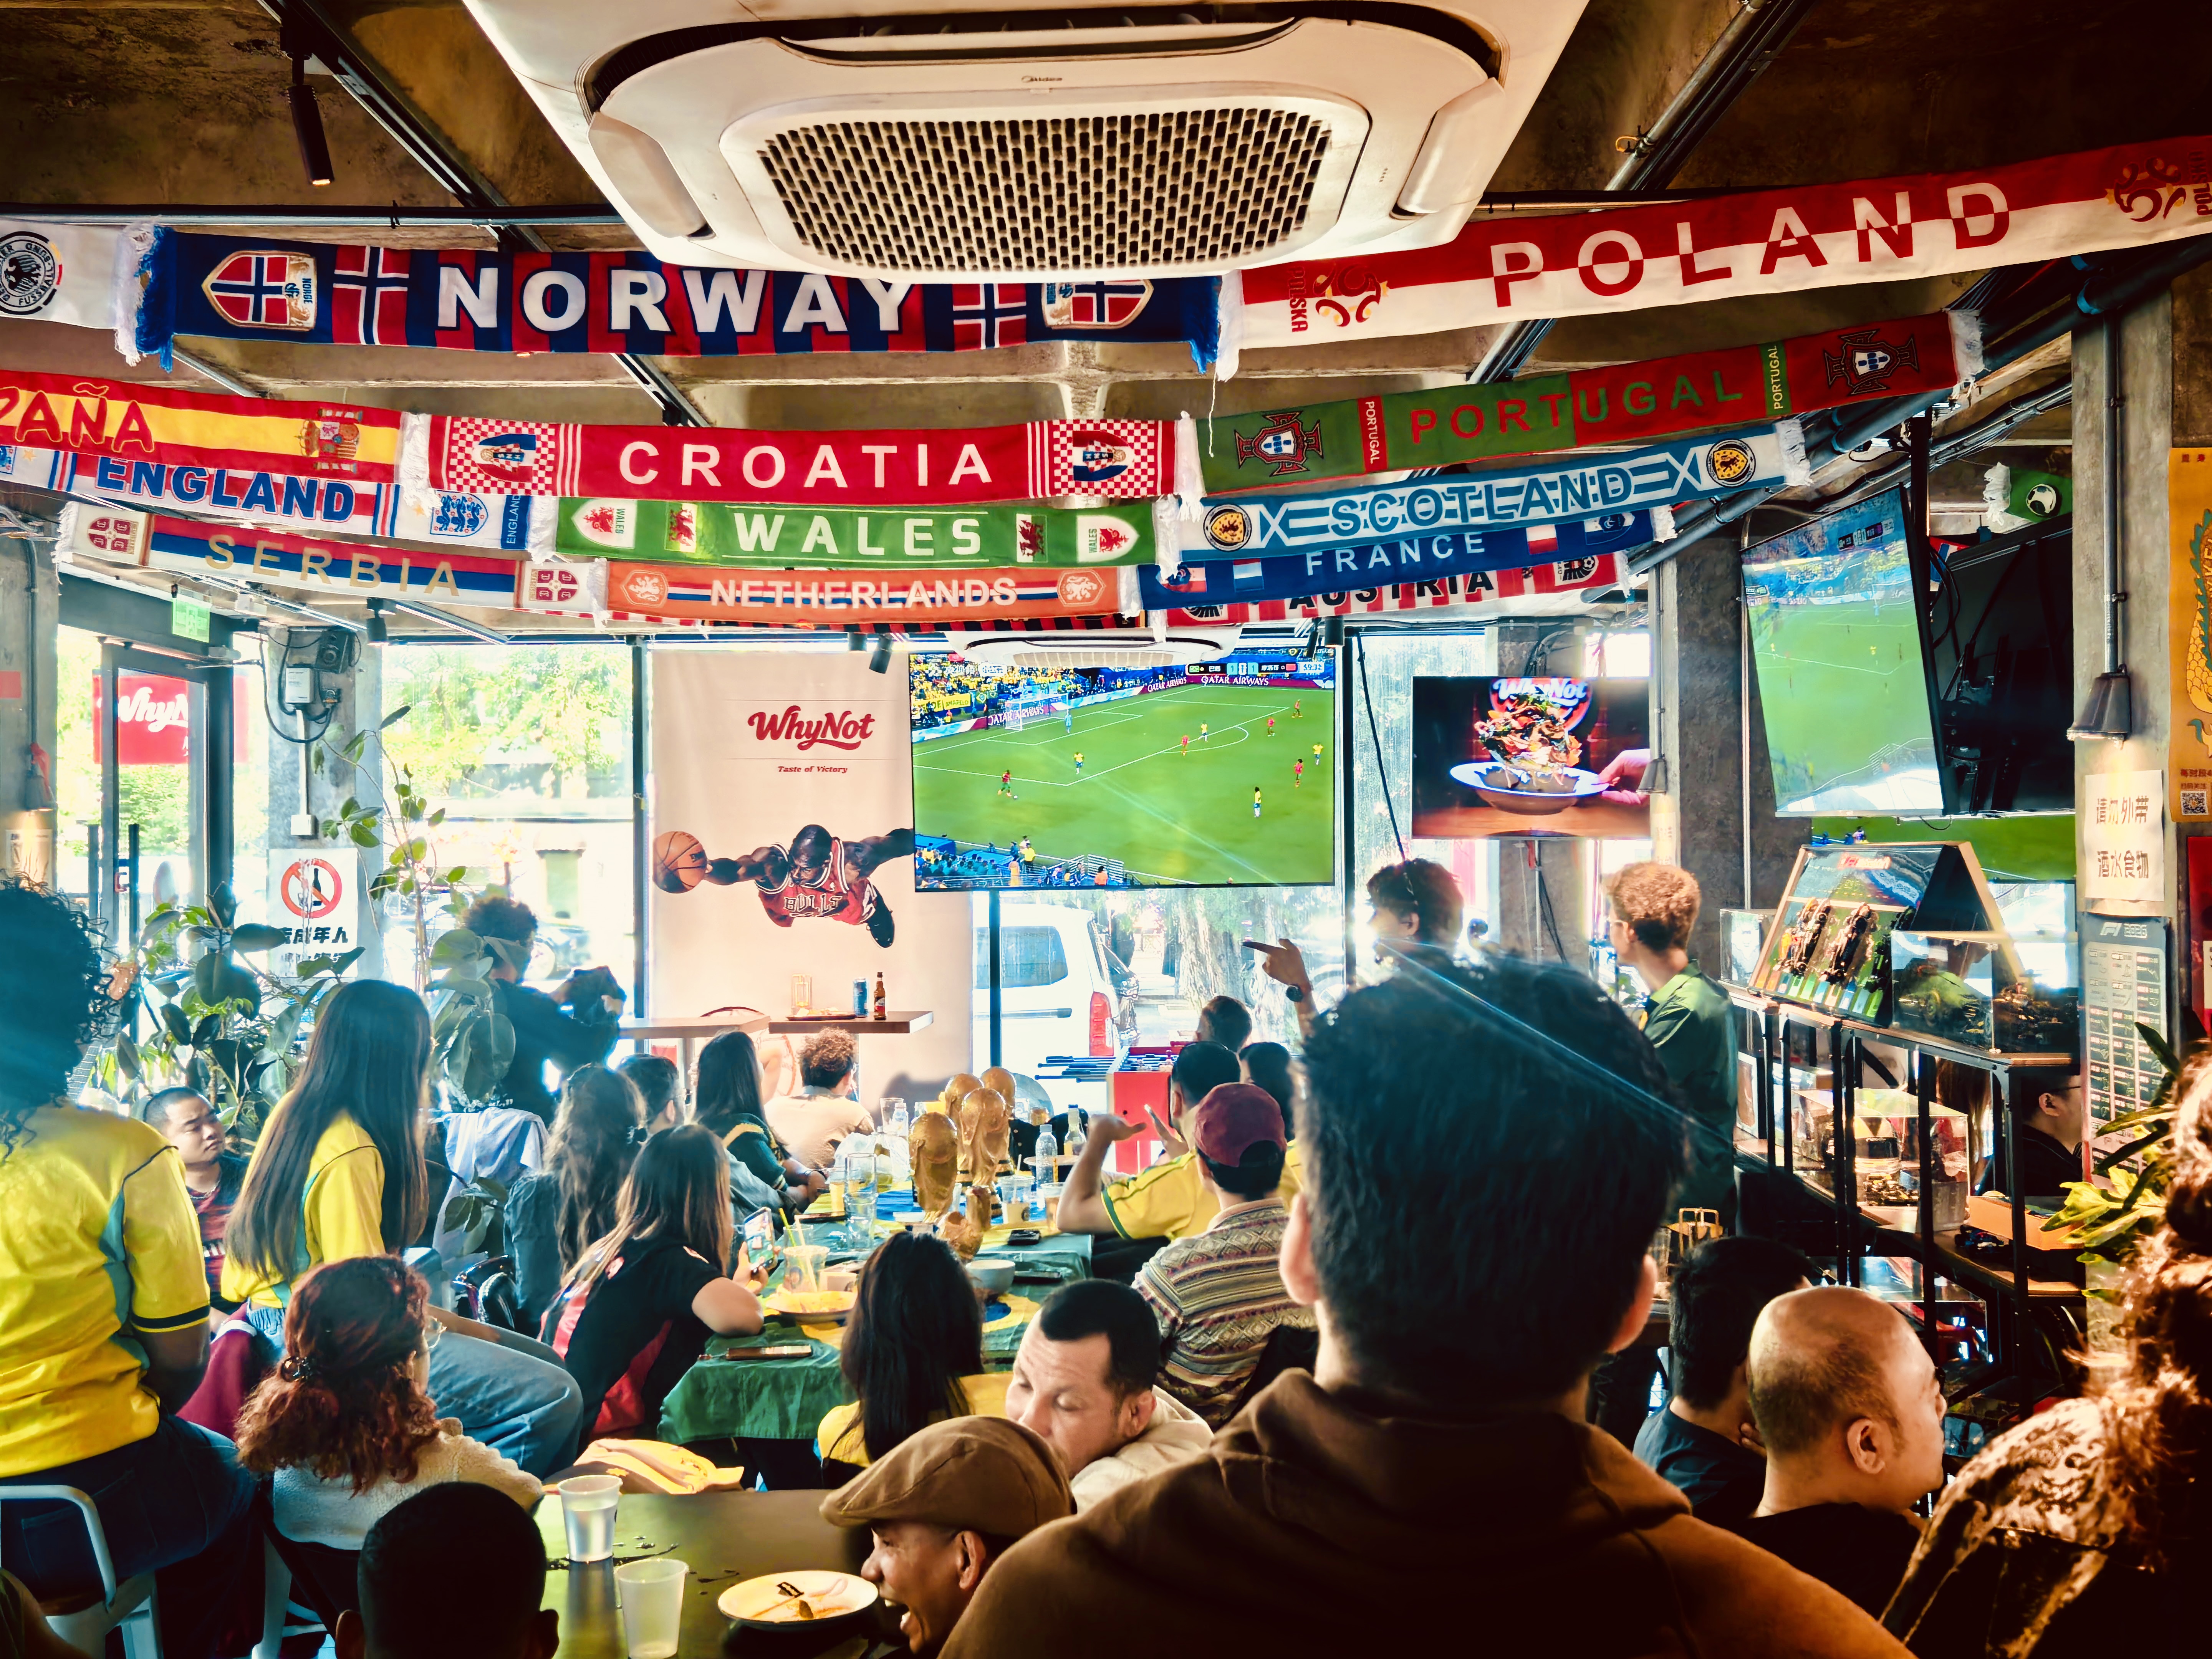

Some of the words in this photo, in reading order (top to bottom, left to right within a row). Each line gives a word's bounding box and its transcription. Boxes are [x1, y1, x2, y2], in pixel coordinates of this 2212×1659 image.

[1490, 183, 2009, 306] POLAND
[437, 267, 912, 332] NORWAY
[1287, 266, 1308, 332] POLSKA
[1411, 371, 1742, 444] PORTUGAL
[1770, 345, 1782, 409] PORTUGAL
[1365, 401, 1381, 464] PORTUGAL
[95, 453, 358, 523] ENGLAND
[619, 441, 992, 488] CROATIA
[1332, 467, 1633, 536] SCOTLAND
[734, 513, 981, 556] WALES
[1306, 534, 1486, 575] FRANCE
[205, 535, 459, 596] SERBIA
[711, 578, 1017, 609] NETHERLANDS
[1201, 675, 1229, 685] QATAR
[1232, 675, 1269, 686] AIRWAYS
[747, 705, 875, 750] WhyNot
[2096, 795, 2149, 824] 请勿外带
[2097, 849, 2149, 879] 酒水食物
